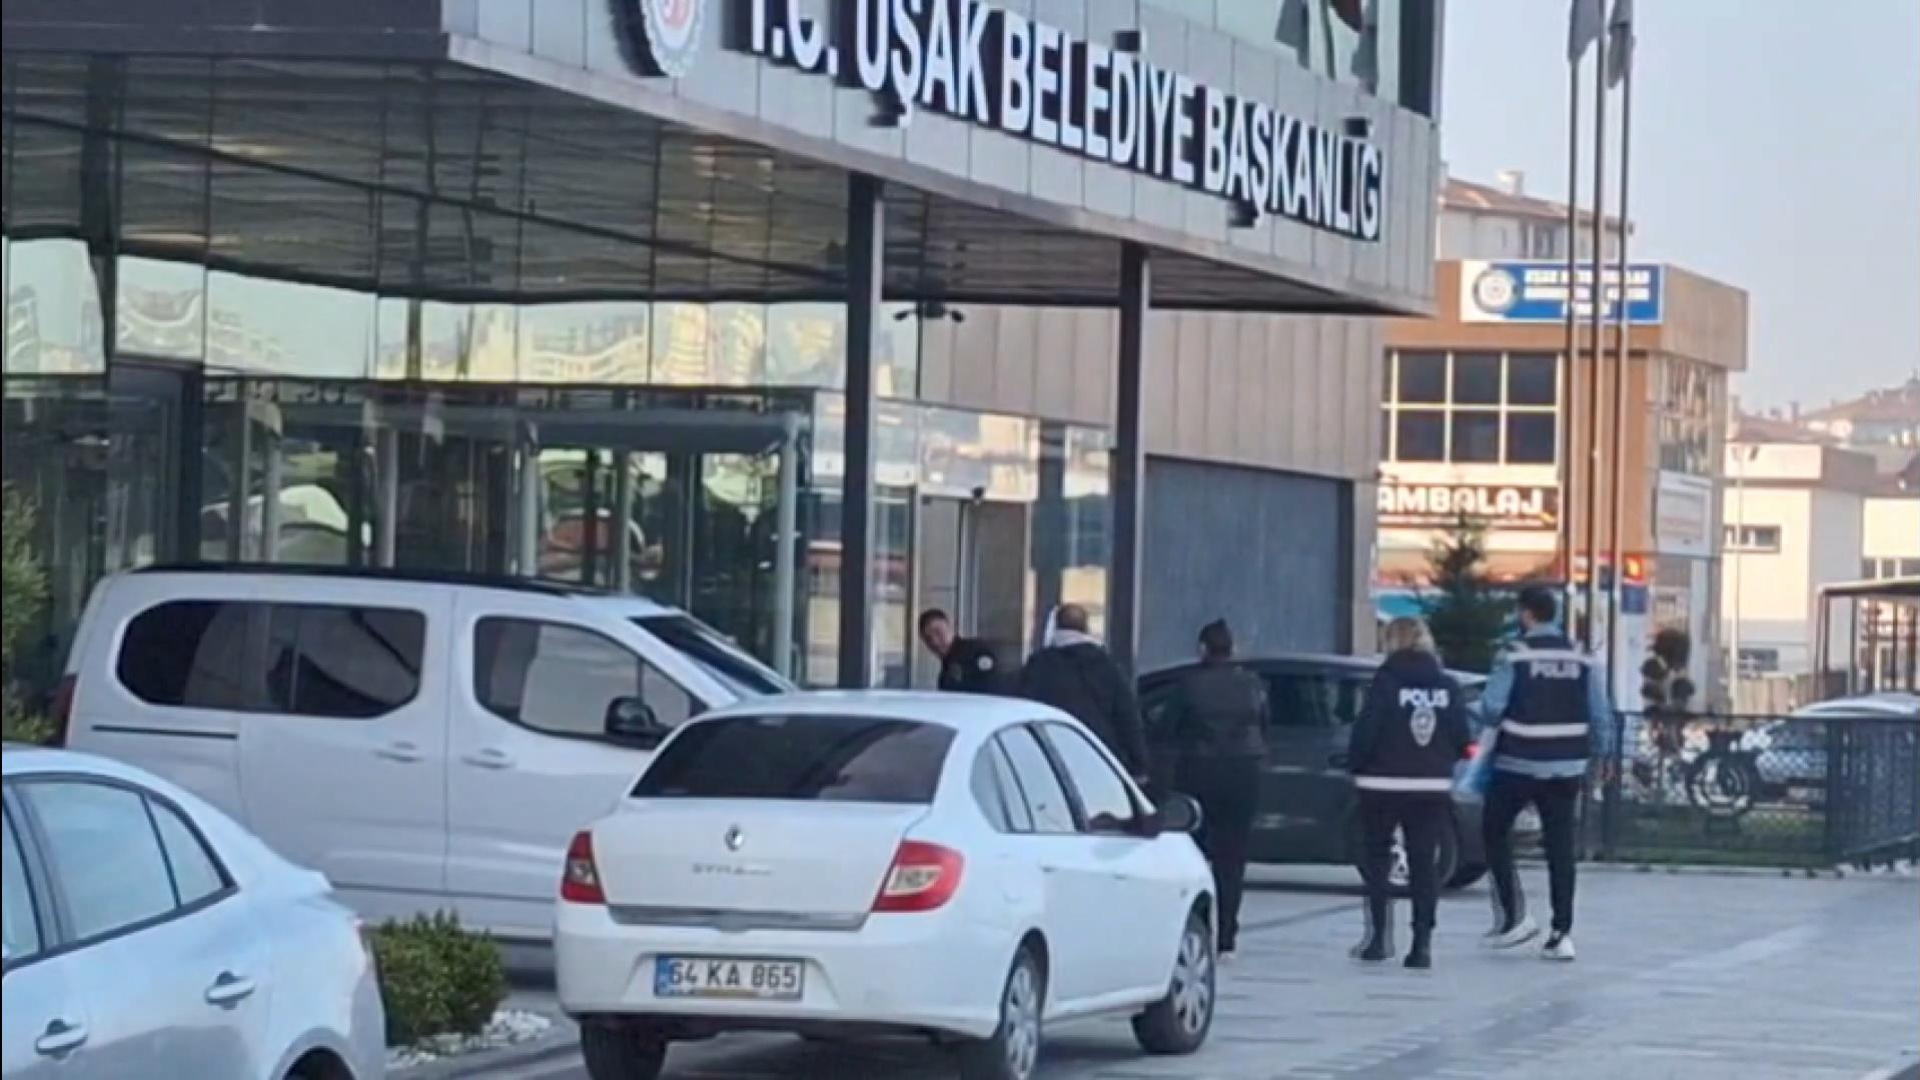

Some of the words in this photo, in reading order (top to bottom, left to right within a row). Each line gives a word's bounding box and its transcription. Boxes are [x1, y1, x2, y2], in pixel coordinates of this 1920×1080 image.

[856, 0, 989, 127] UŞAK
[1001, 8, 1195, 184] BELEDİYE
[669, 961, 697, 985] 64
[707, 961, 740, 986] KA
